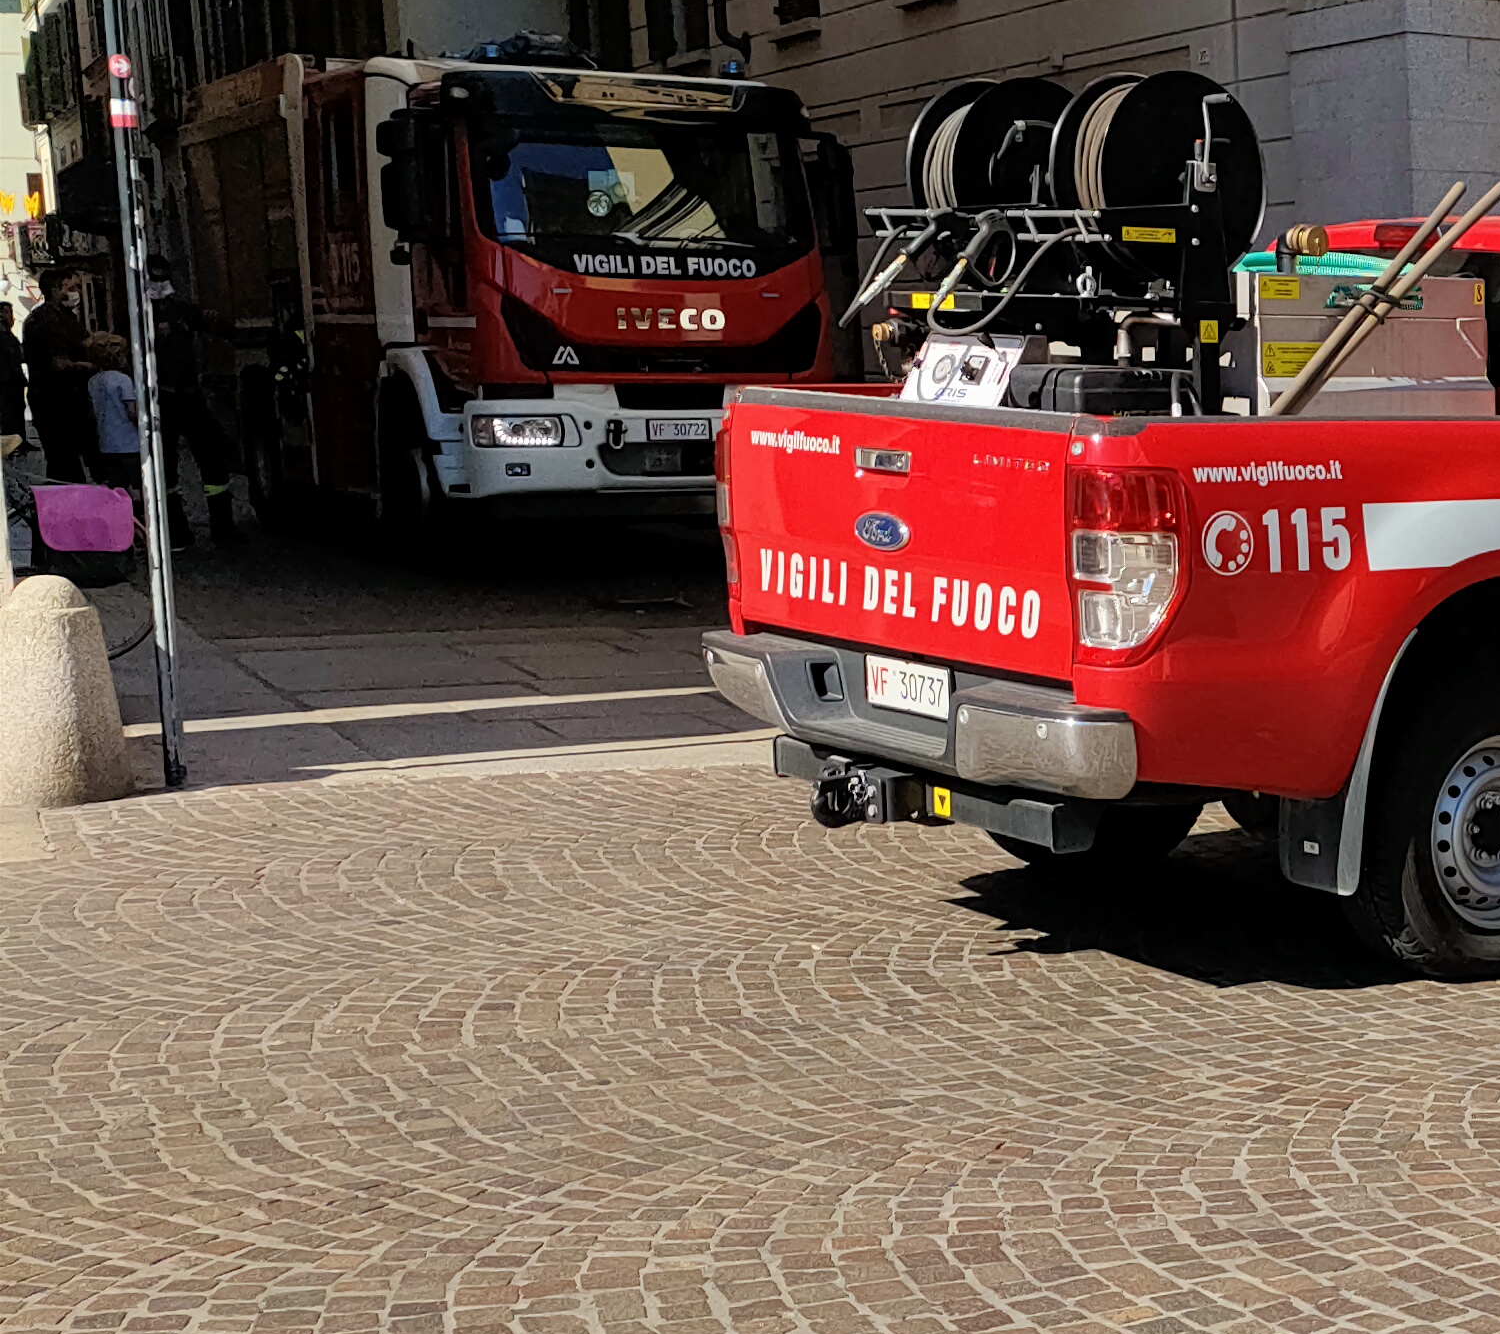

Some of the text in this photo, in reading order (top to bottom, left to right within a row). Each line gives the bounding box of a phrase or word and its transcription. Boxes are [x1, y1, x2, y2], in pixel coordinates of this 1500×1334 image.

[573, 253, 757, 278] VIGILI DEL FUOCO
[616, 307, 726, 331] IVECO
[652, 422, 707, 437] VF 30722
[750, 428, 841, 455] www.vigilfuoco.it
[1192, 459, 1344, 488] www.vigilfuoco.it
[1262, 506, 1352, 573] 115
[760, 548, 1041, 639] VIGILI DEL FUOCO
[870, 664, 944, 707] VF 30737
